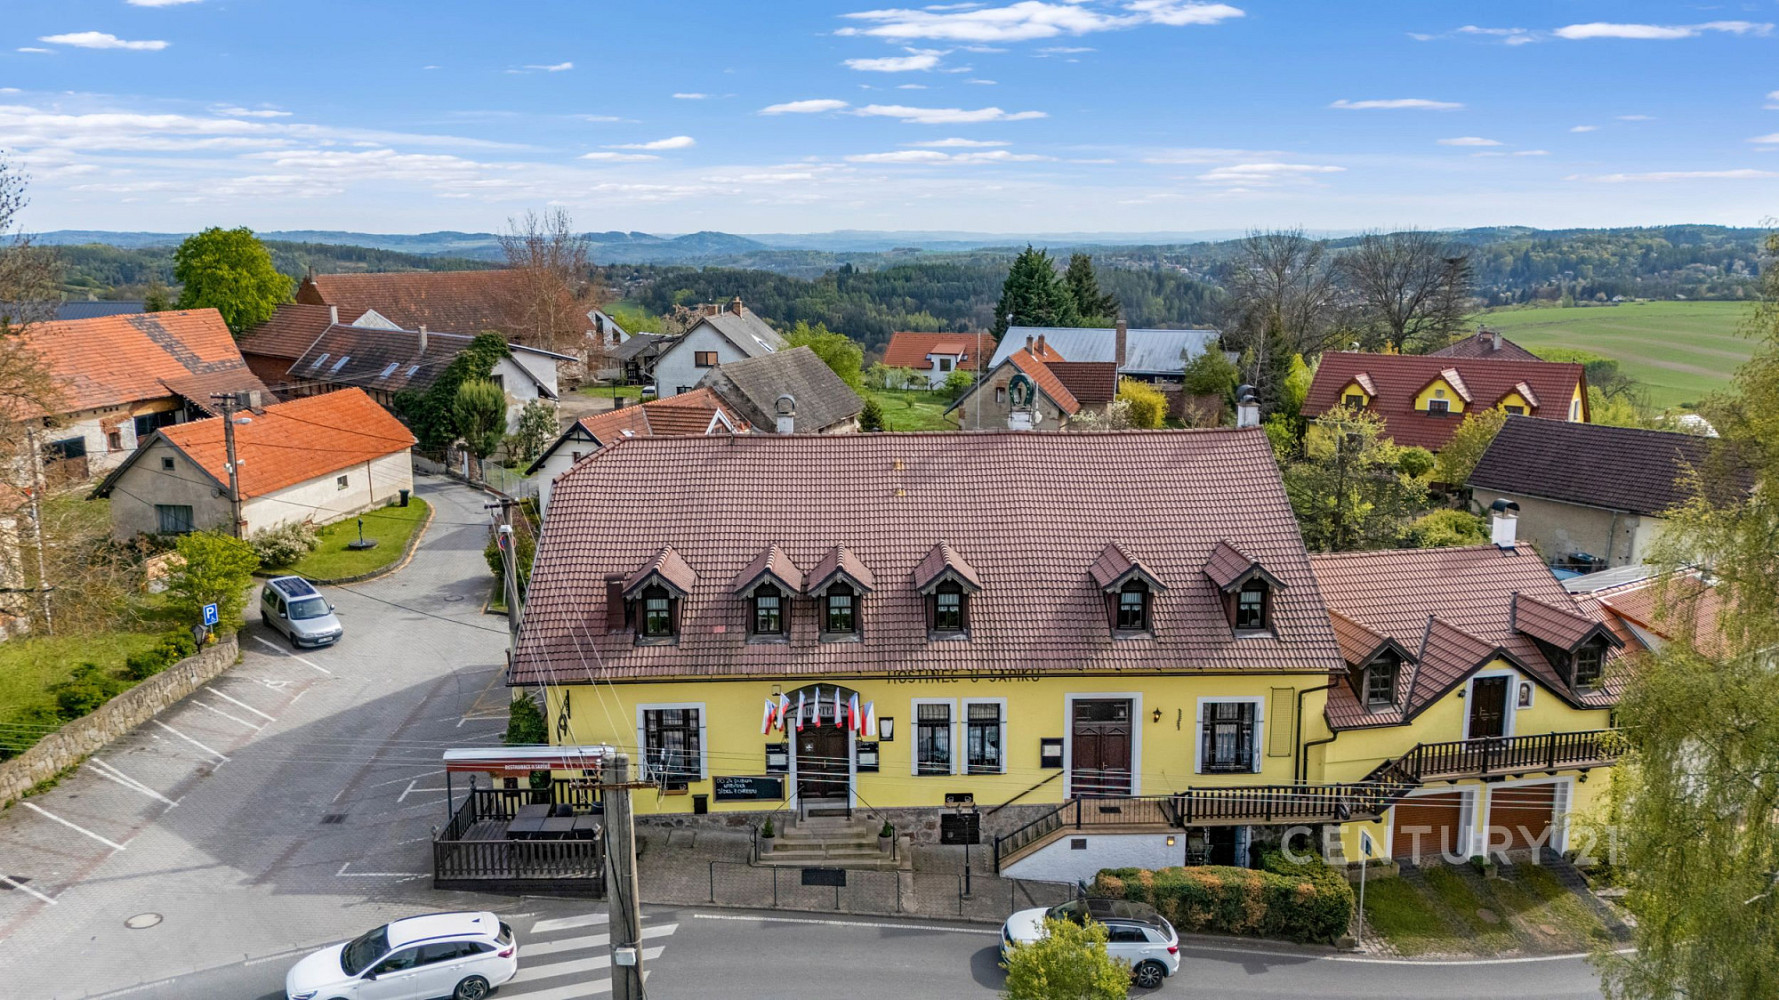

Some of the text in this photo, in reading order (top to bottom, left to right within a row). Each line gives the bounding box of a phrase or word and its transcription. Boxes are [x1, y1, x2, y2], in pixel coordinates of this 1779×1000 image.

[206, 607, 215, 619] P
[887, 670, 959, 684] HOSTINEC
[970, 669, 979, 683] U
